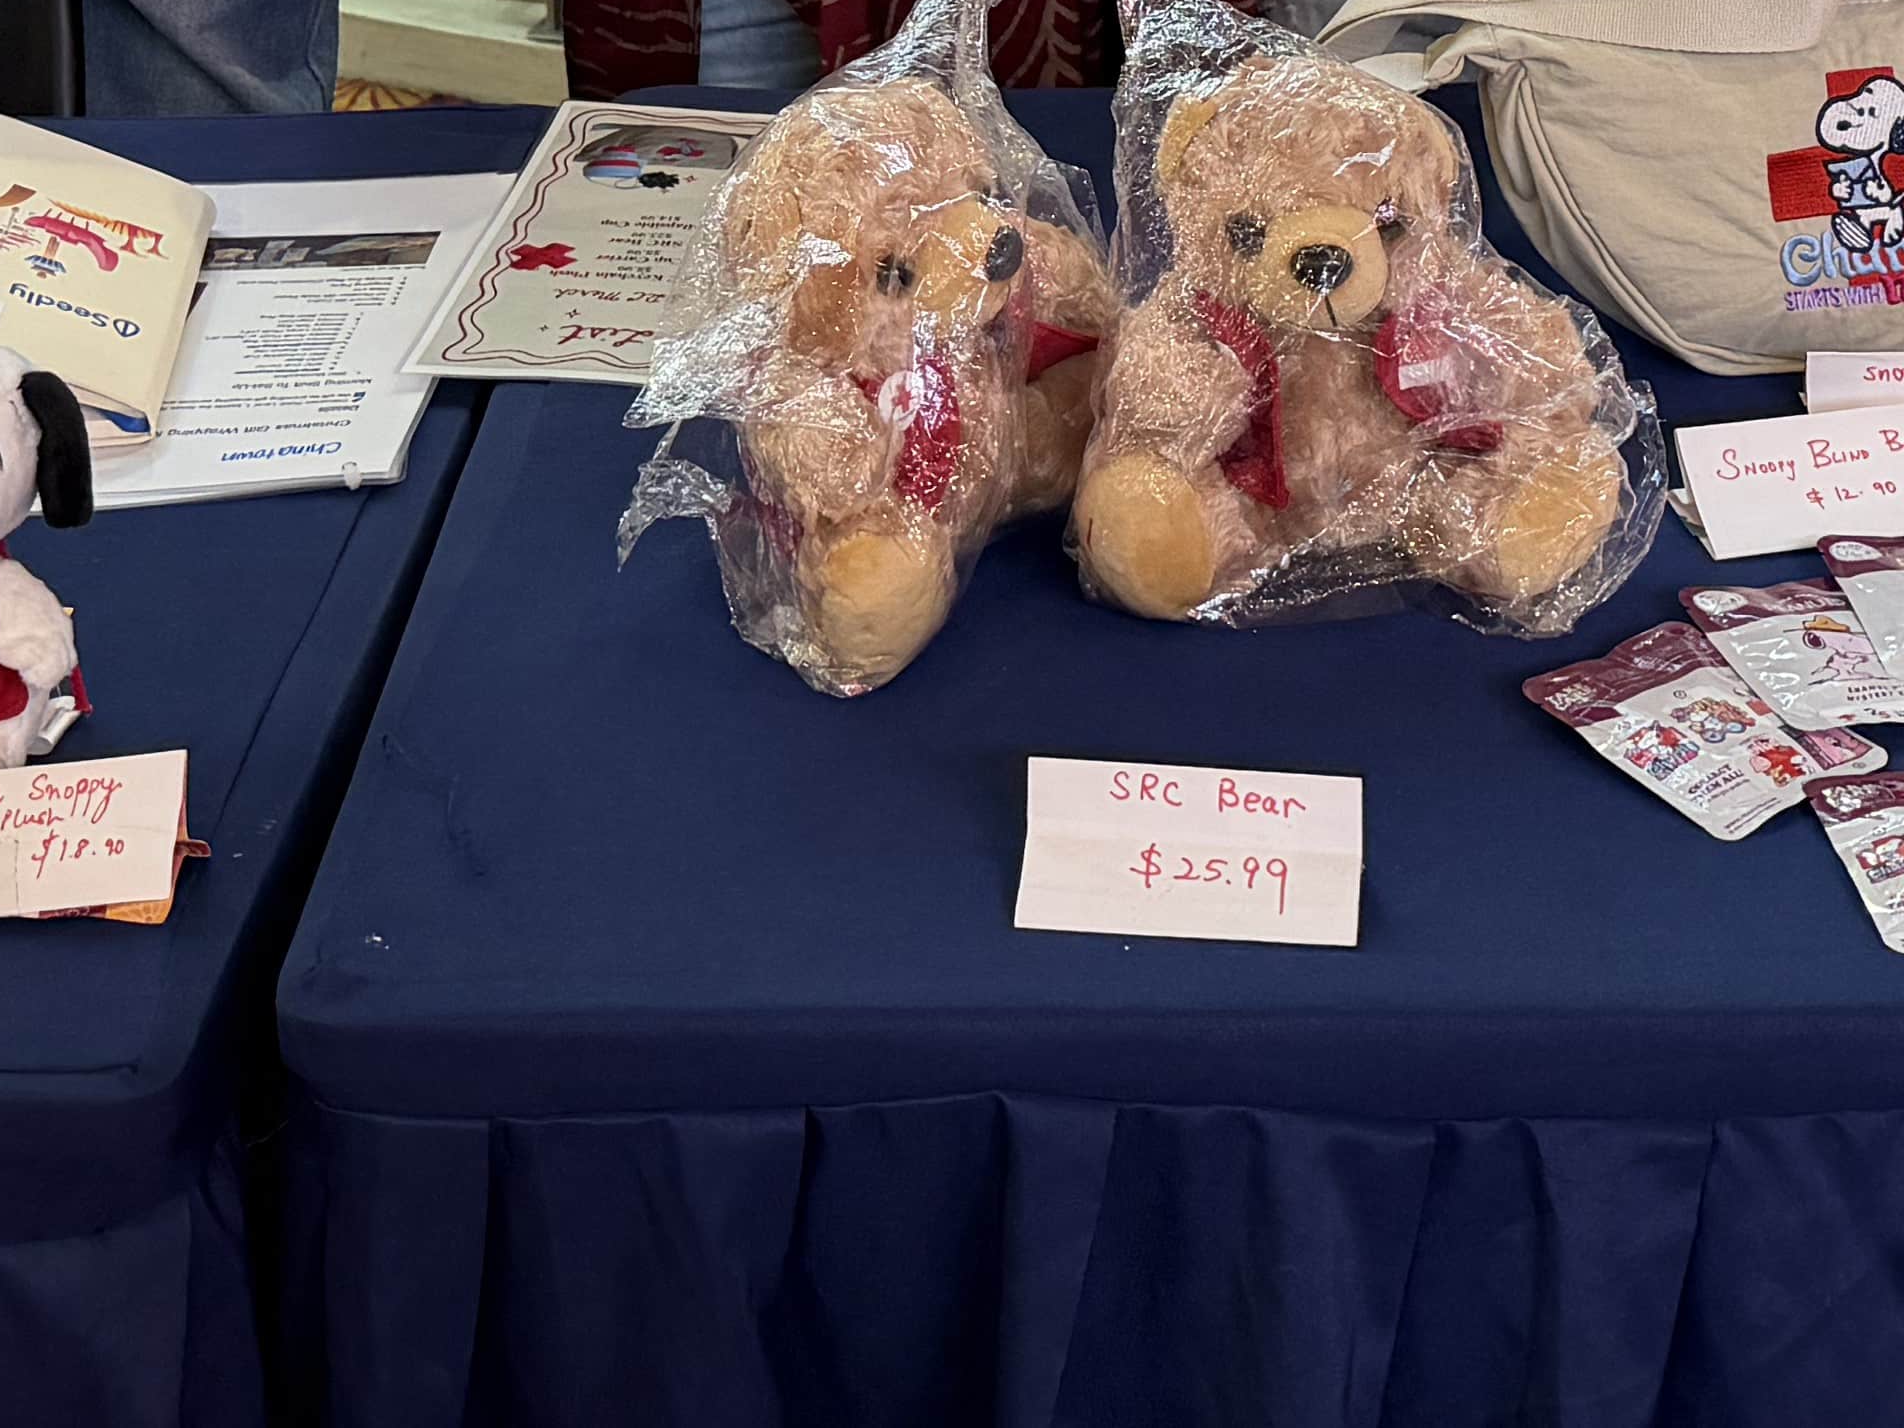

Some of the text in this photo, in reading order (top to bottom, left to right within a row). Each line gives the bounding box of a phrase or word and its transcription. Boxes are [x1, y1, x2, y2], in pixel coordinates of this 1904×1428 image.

[8, 282, 110, 328] Seedly
[557, 324, 654, 348] List
[167, 426, 238, 438] Wrapping
[275, 419, 352, 430] Christmas
[221, 441, 342, 464] Chinatown
[1107, 768, 1307, 818] SRC Bear
[1128, 844, 1292, 914] $25.99
